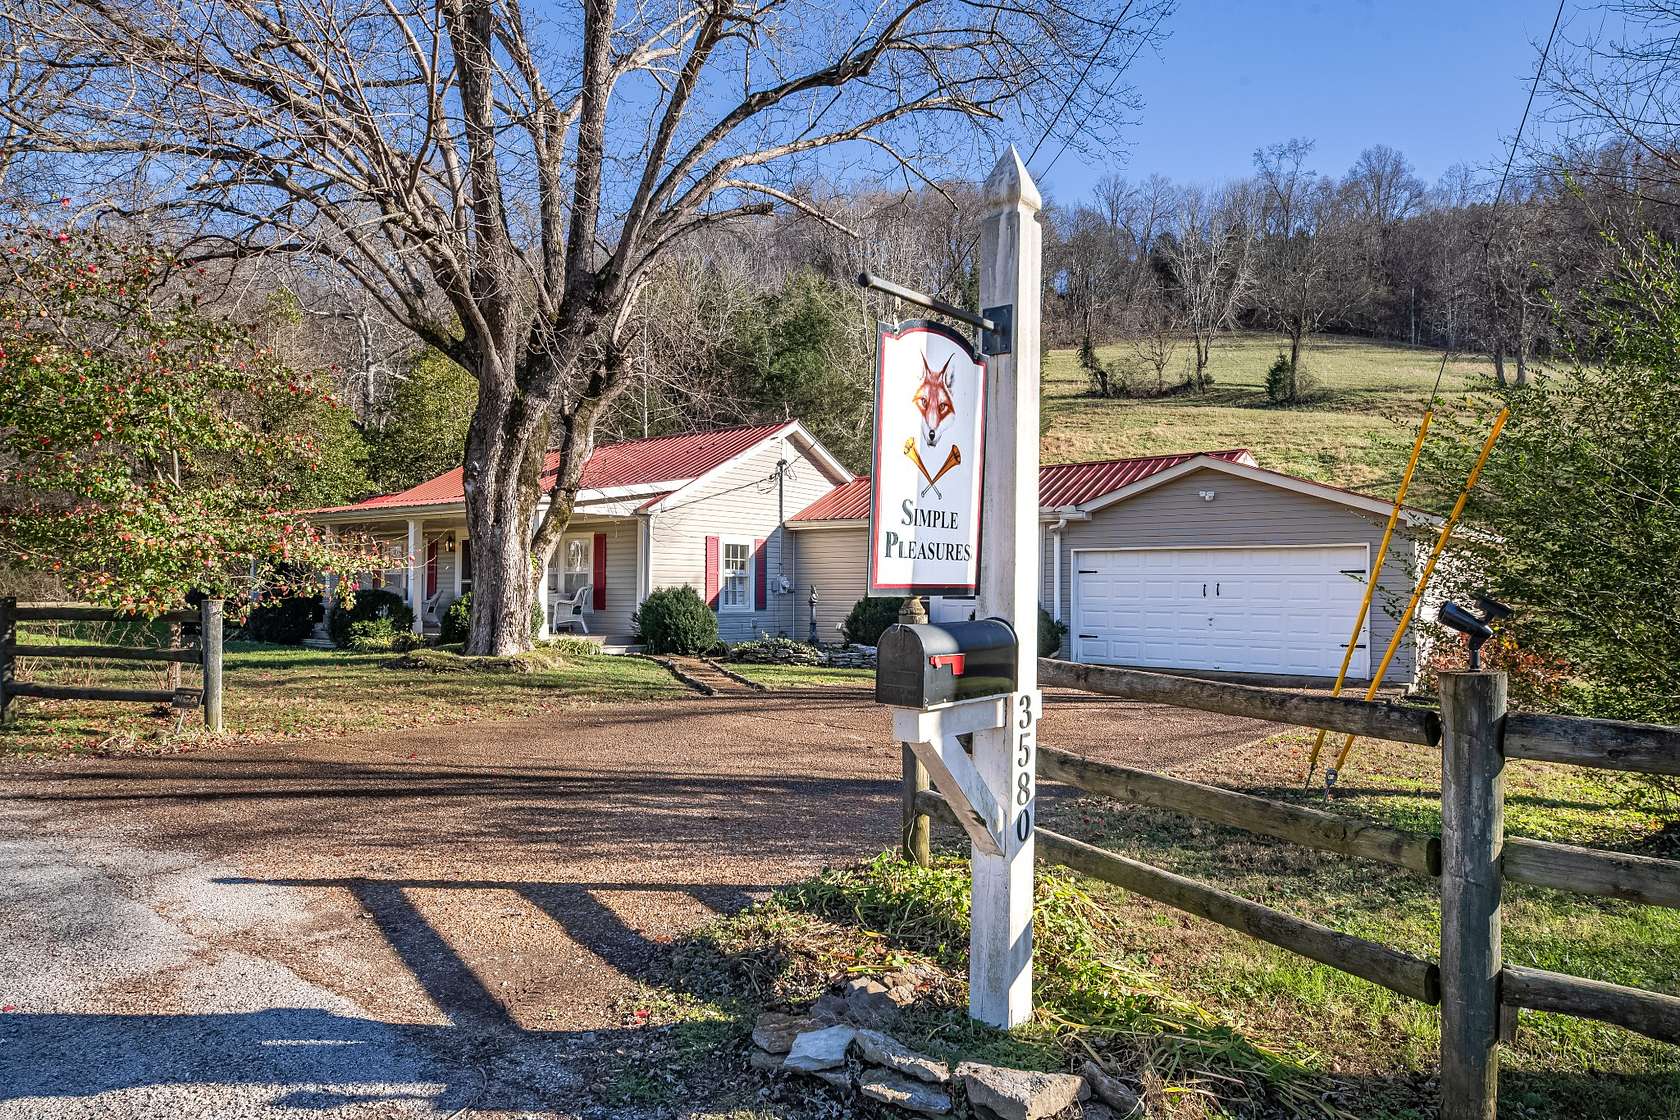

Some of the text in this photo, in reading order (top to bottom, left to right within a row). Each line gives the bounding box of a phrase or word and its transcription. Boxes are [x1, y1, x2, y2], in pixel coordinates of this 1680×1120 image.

[901, 499, 958, 529] SIMPLE
[885, 531, 971, 561] PLEASURES
[1017, 694, 1032, 842] 3580
